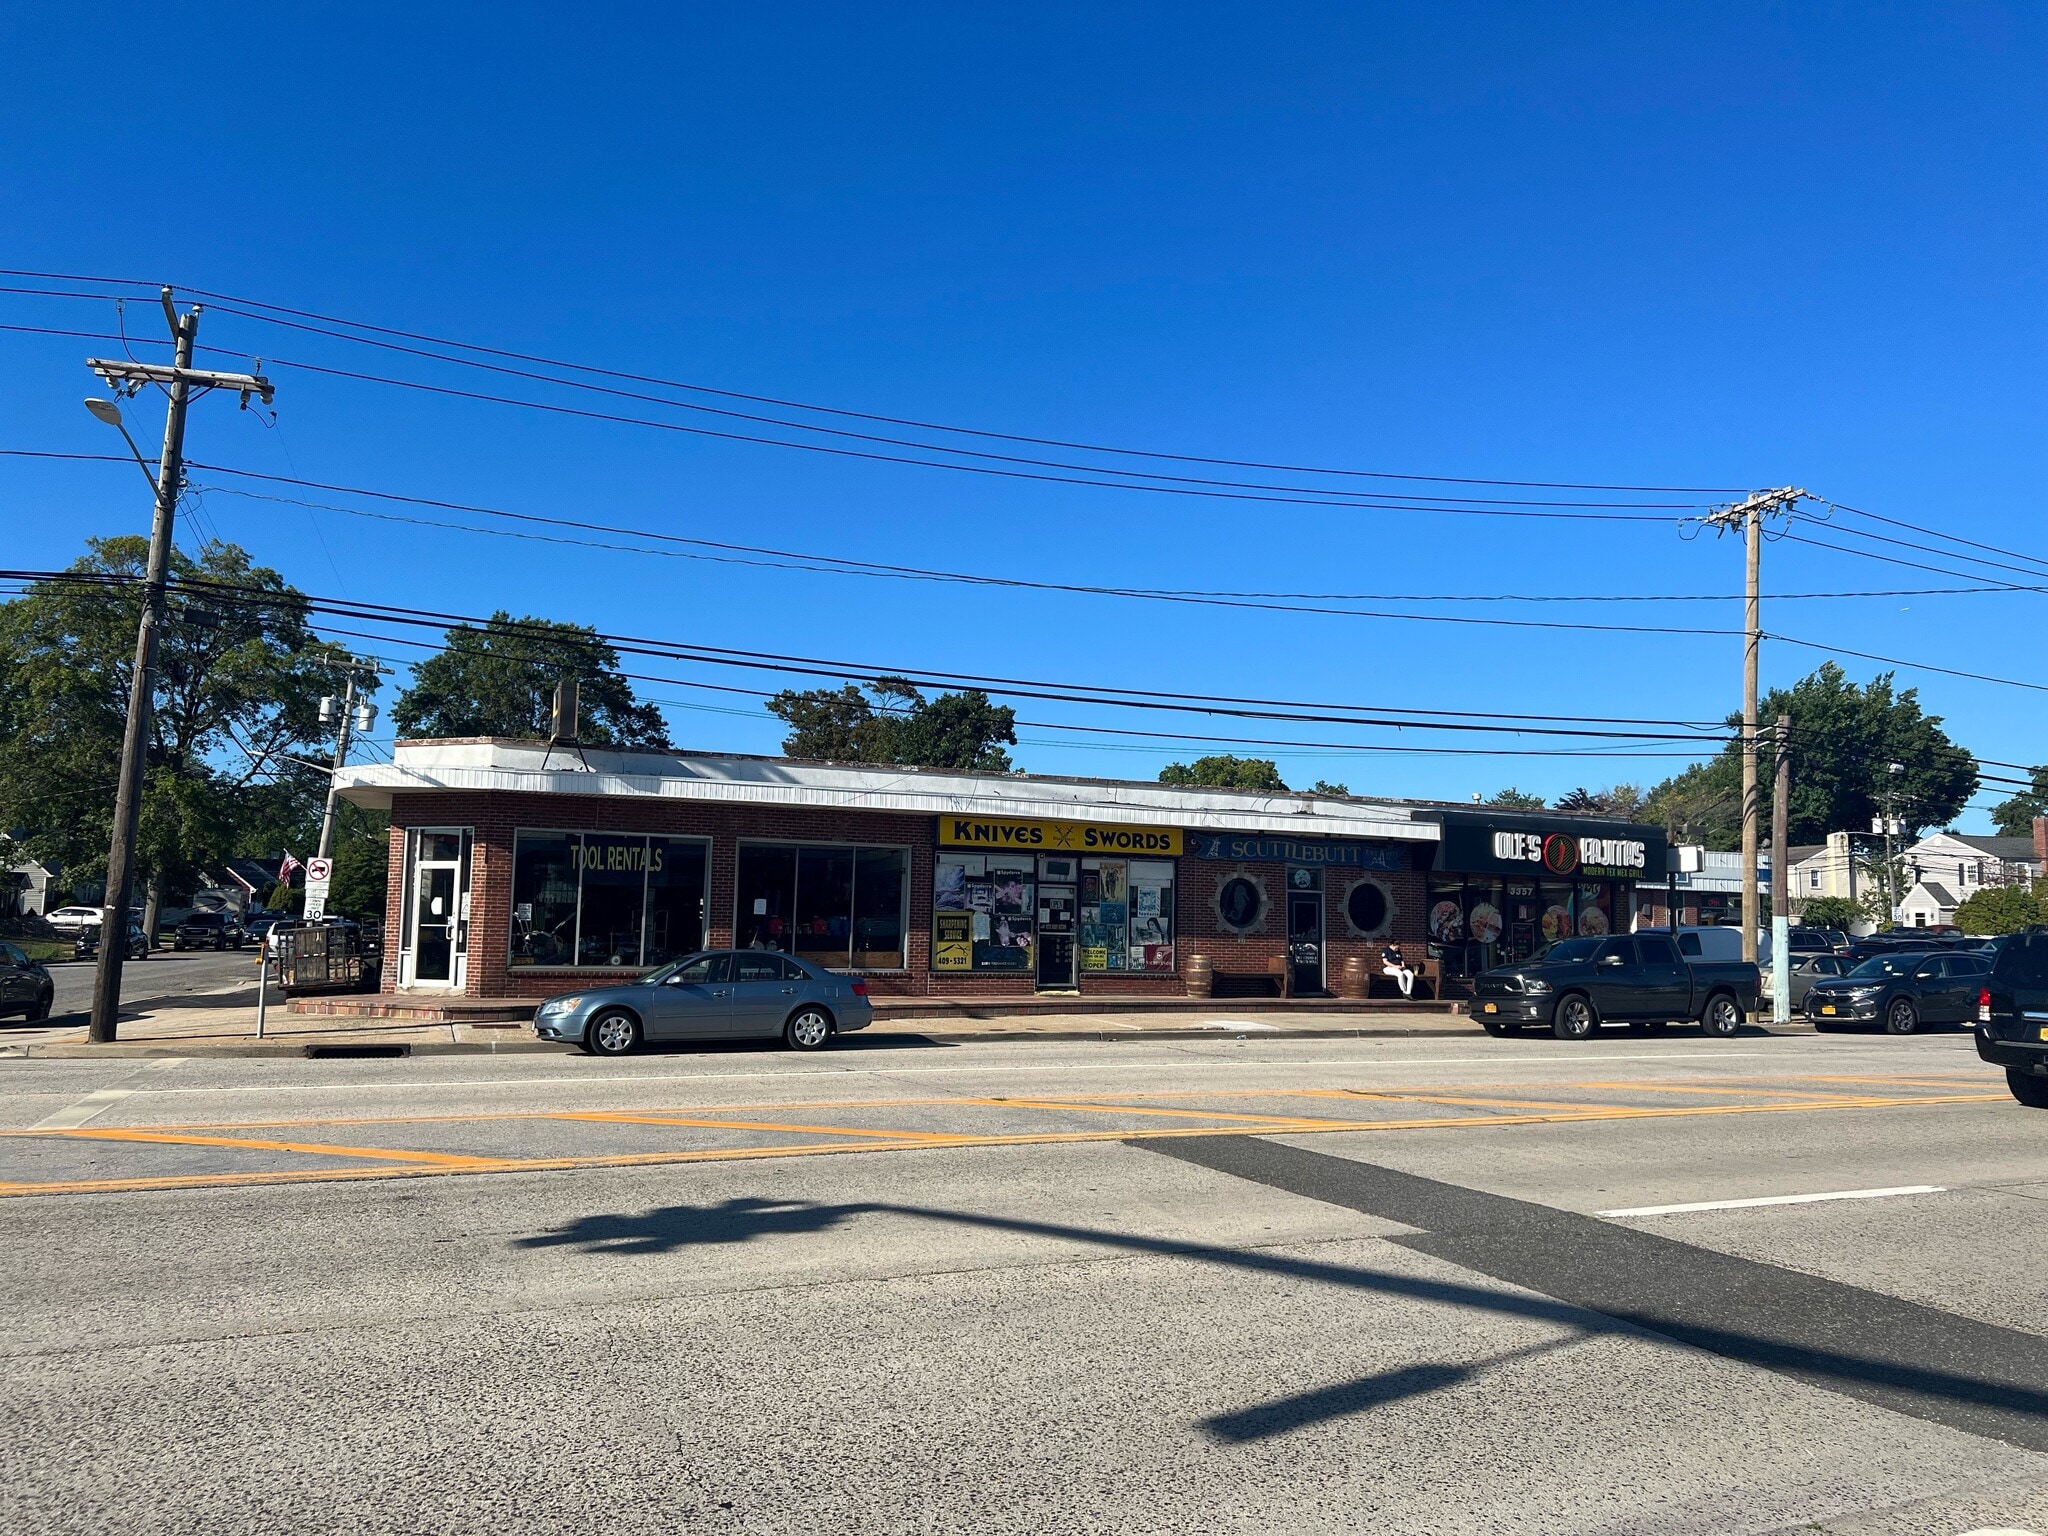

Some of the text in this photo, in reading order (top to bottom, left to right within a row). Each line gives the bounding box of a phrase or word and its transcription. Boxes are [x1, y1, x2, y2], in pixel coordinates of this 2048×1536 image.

[954, 820, 1171, 850] KNIVES SWORDS
[1231, 840, 1361, 862] SCUTTLEBUTT
[1494, 831, 1645, 868] OLE'S FAJITAS
[570, 845, 663, 872] TOOL RENTALS
[1582, 866, 1605, 876] MODERN
[1606, 868, 1616, 877] TEX
[1617, 869, 1628, 878] MEX
[1509, 887, 1533, 896] 3357
[306, 910, 321, 919] 30
[940, 918, 967, 929] SHARPENING
[944, 929, 963, 940] SERVICE
